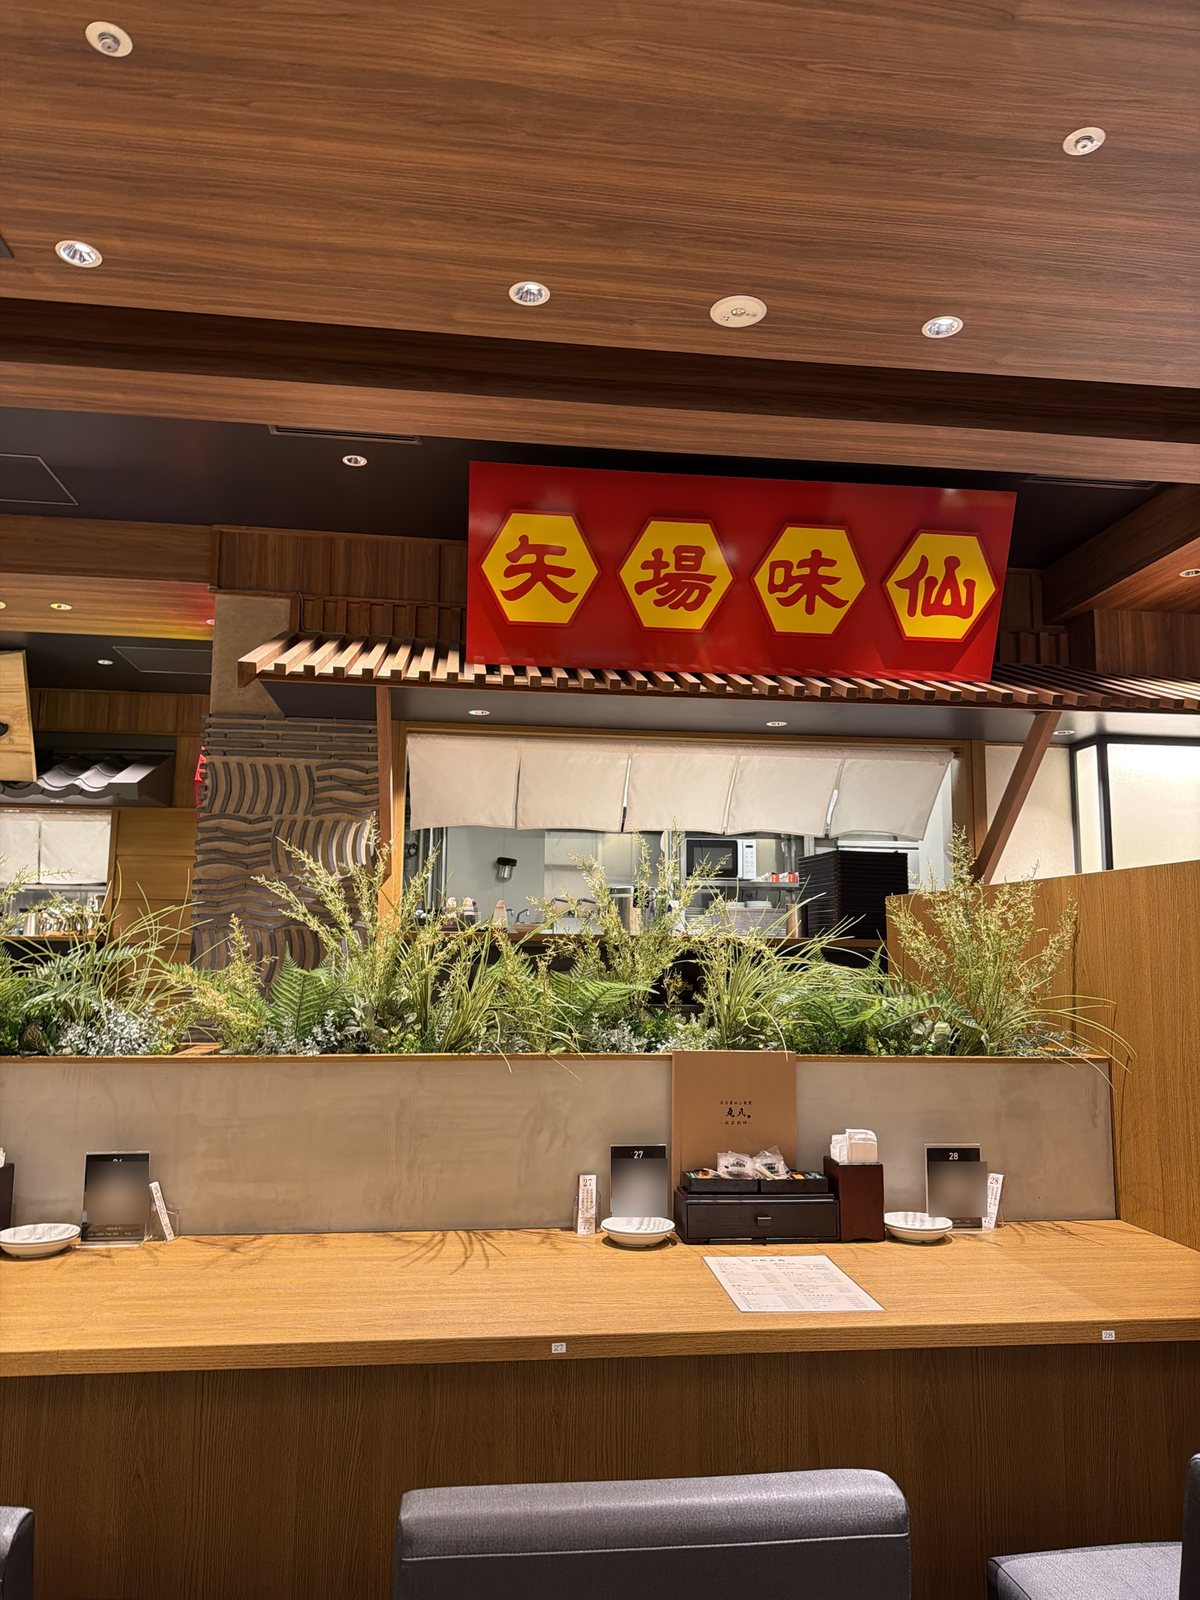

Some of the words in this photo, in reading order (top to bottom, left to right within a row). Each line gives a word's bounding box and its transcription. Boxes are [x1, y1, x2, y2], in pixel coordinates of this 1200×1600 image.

[500, 534, 976, 619] 矢場味仙
[633, 1150, 644, 1159] 27
[948, 1152, 959, 1160] 28
[582, 1178, 593, 1187] 27
[1103, 1331, 1113, 1339] 28
[553, 1344, 564, 1352] 27
